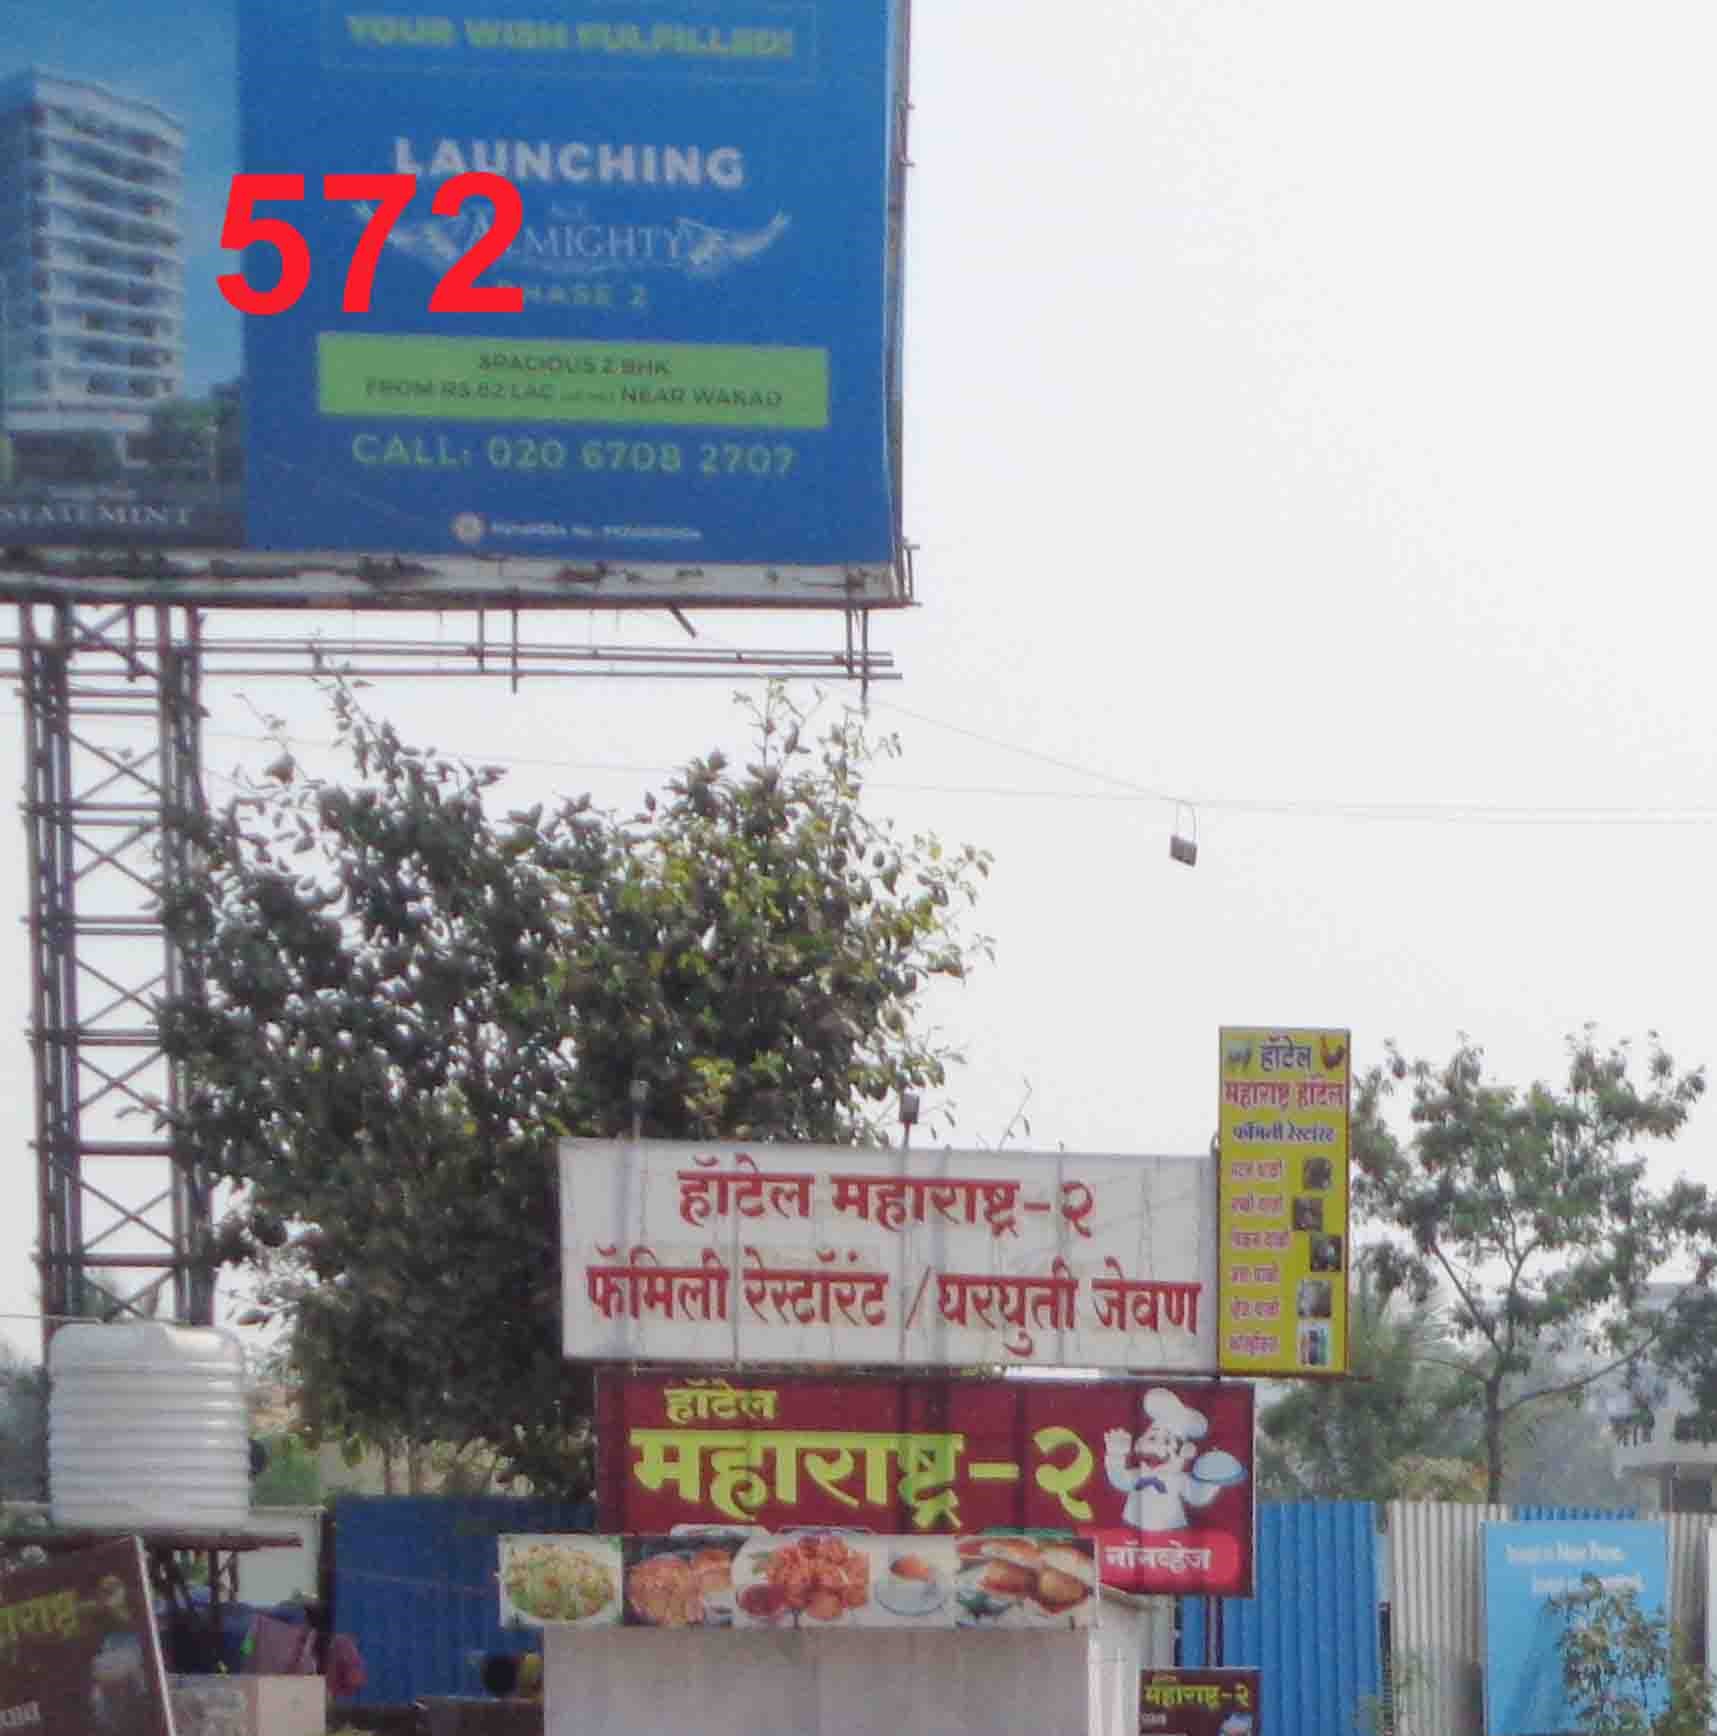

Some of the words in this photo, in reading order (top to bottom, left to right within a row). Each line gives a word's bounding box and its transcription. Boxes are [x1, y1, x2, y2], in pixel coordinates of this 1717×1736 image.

[346, 15, 454, 46] YOUR
[465, 18, 566, 50] WISH
[394, 137, 744, 188] LAUNCHING
[352, 432, 471, 466] CALL:
[488, 434, 566, 468] 020
[581, 440, 682, 473] 6708
[700, 446, 798, 478] 2707
[677, 1152, 815, 1228] हॉटेल
[1091, 1255, 1203, 1336] जेवण
[664, 1382, 777, 1424] हॉटेल
[629, 1426, 1095, 1529] महाराष्ट्र-२
[1103, 1537, 1212, 1575] नॉनव्हेज
